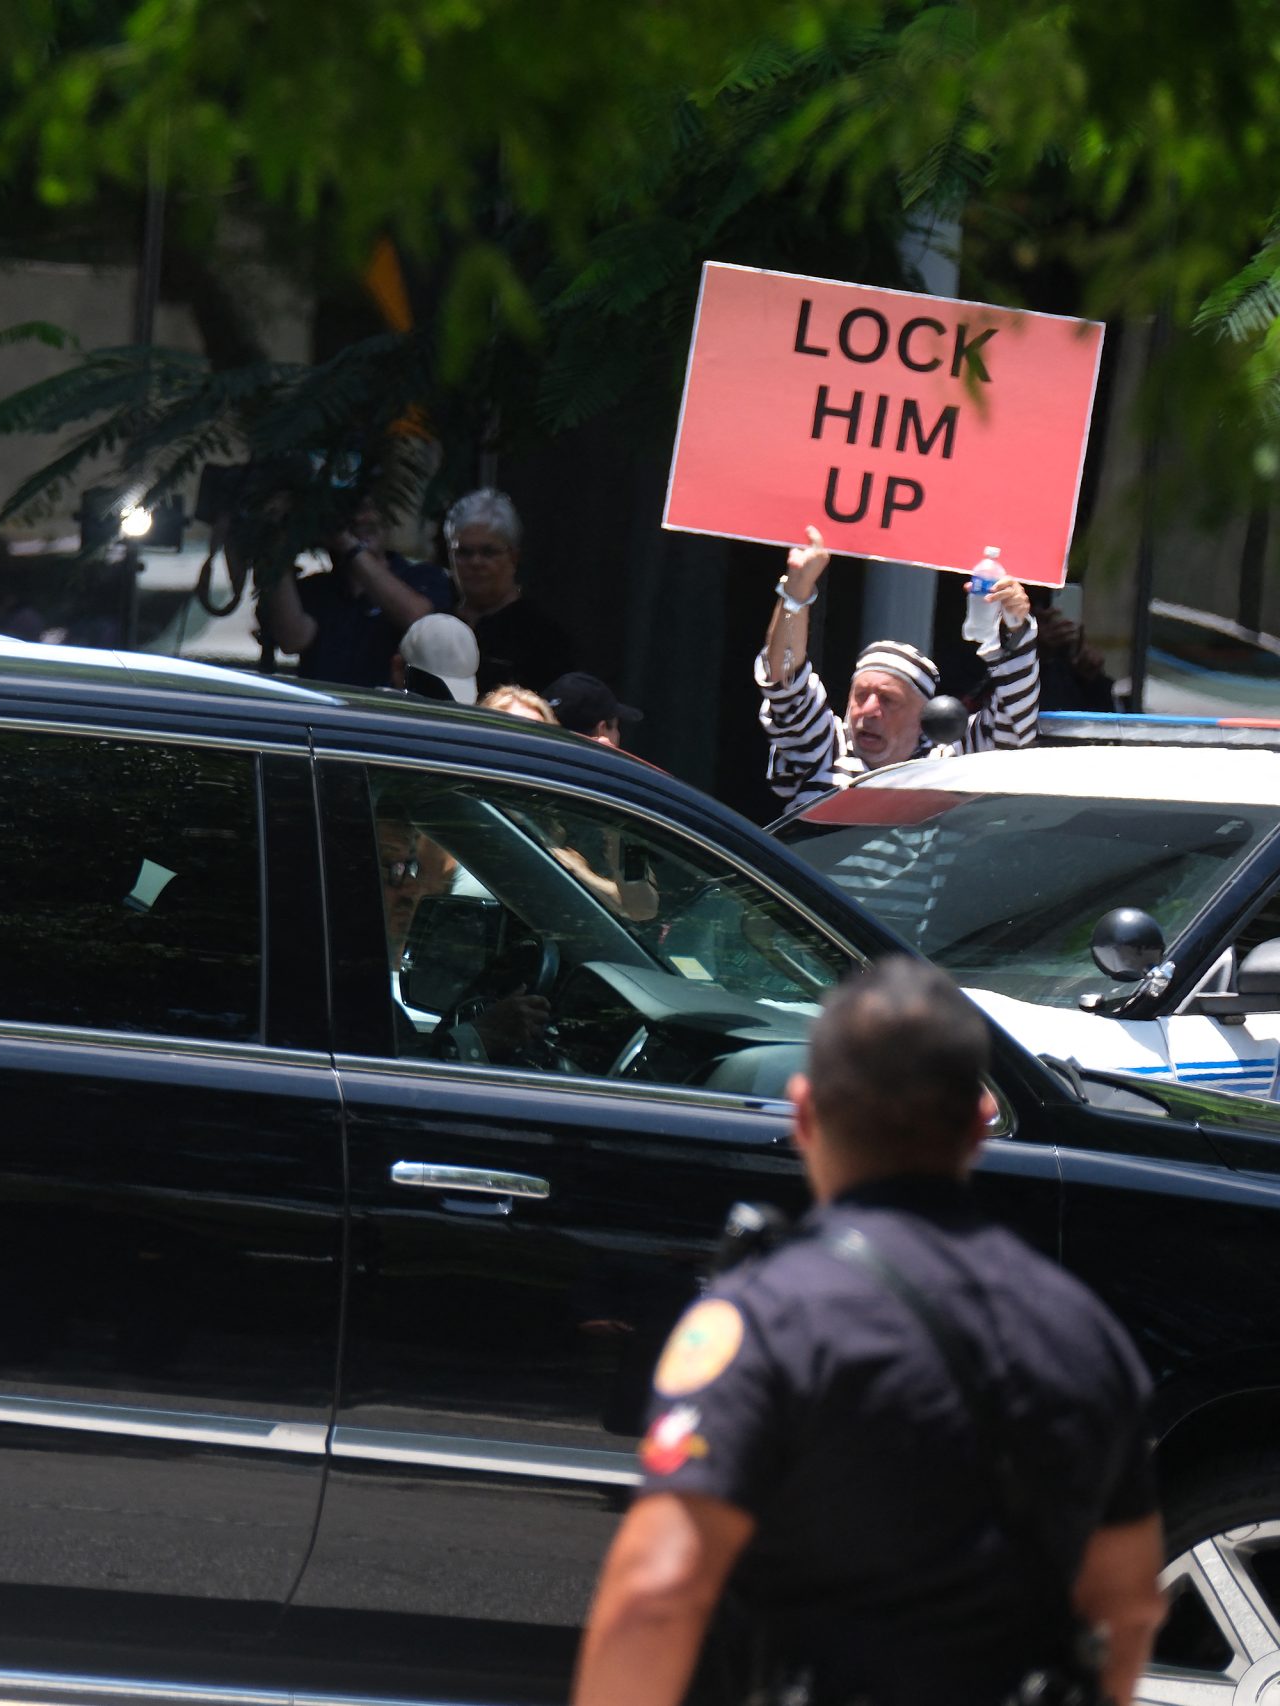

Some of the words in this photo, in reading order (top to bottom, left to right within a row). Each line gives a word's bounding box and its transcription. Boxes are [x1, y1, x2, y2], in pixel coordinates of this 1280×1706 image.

[793, 298, 999, 383] LOCK
[810, 385, 960, 460] HIM
[823, 467, 926, 529] UP
